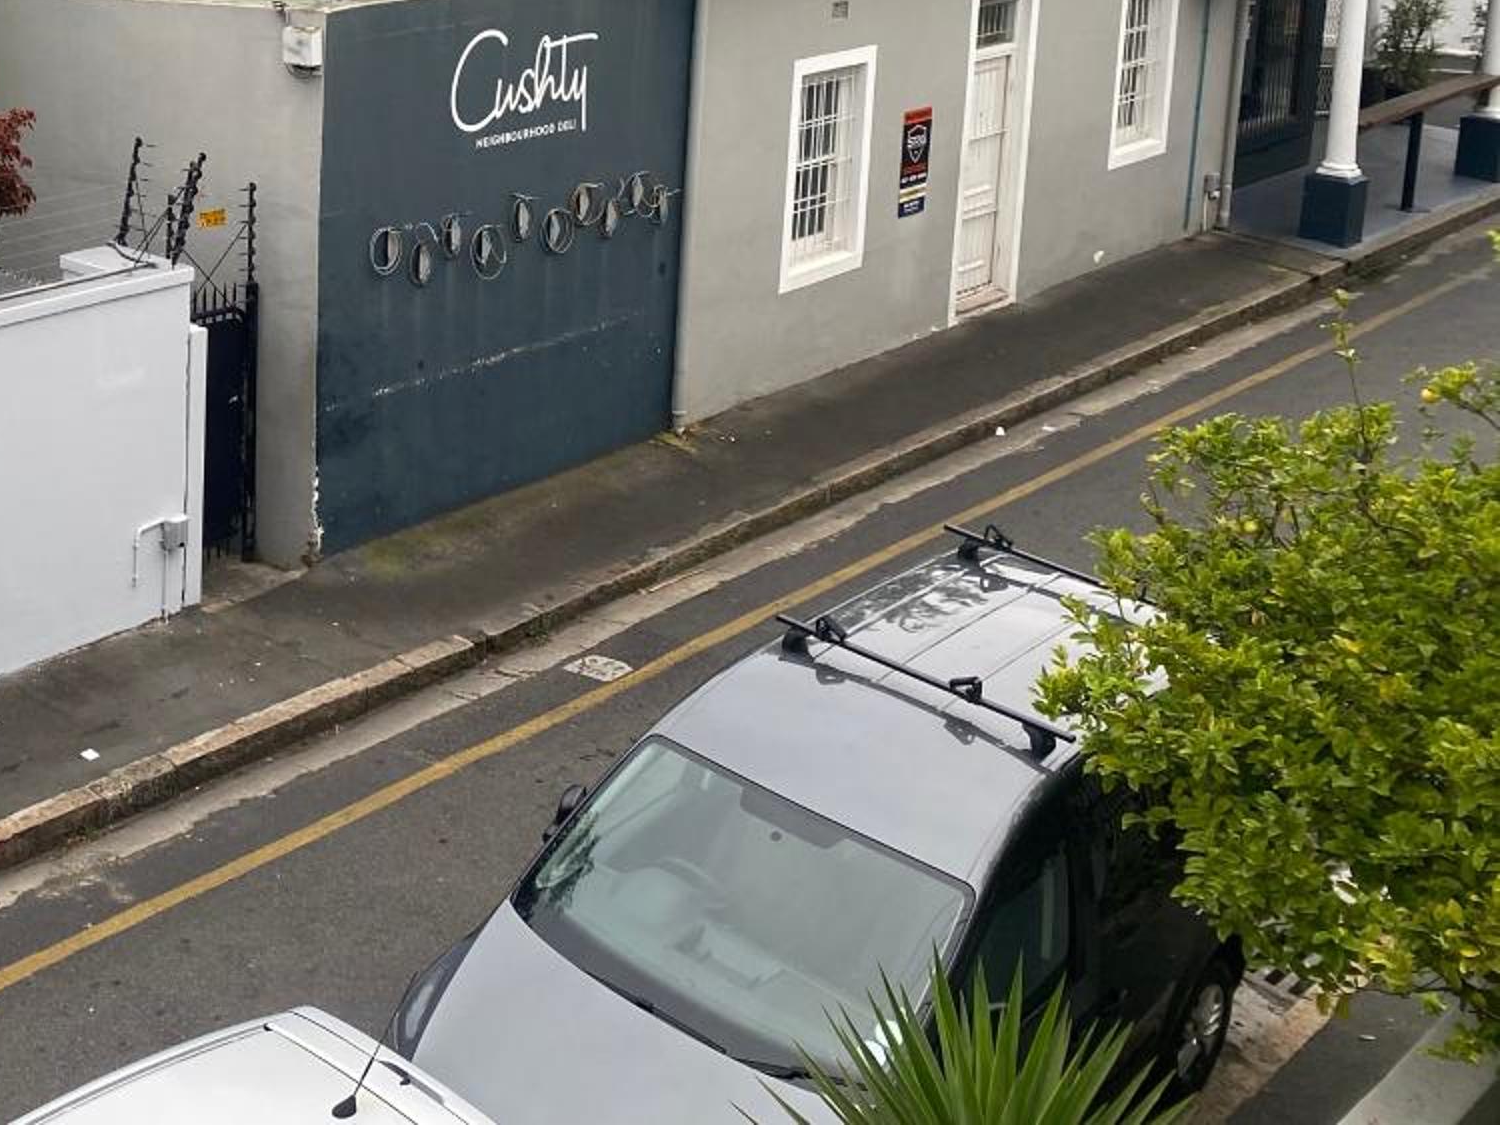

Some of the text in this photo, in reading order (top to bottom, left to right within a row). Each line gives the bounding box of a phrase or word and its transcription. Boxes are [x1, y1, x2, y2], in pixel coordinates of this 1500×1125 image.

[451, 29, 599, 131] Cushty
[475, 118, 577, 149] NEIGHBOURHOOD DELI
